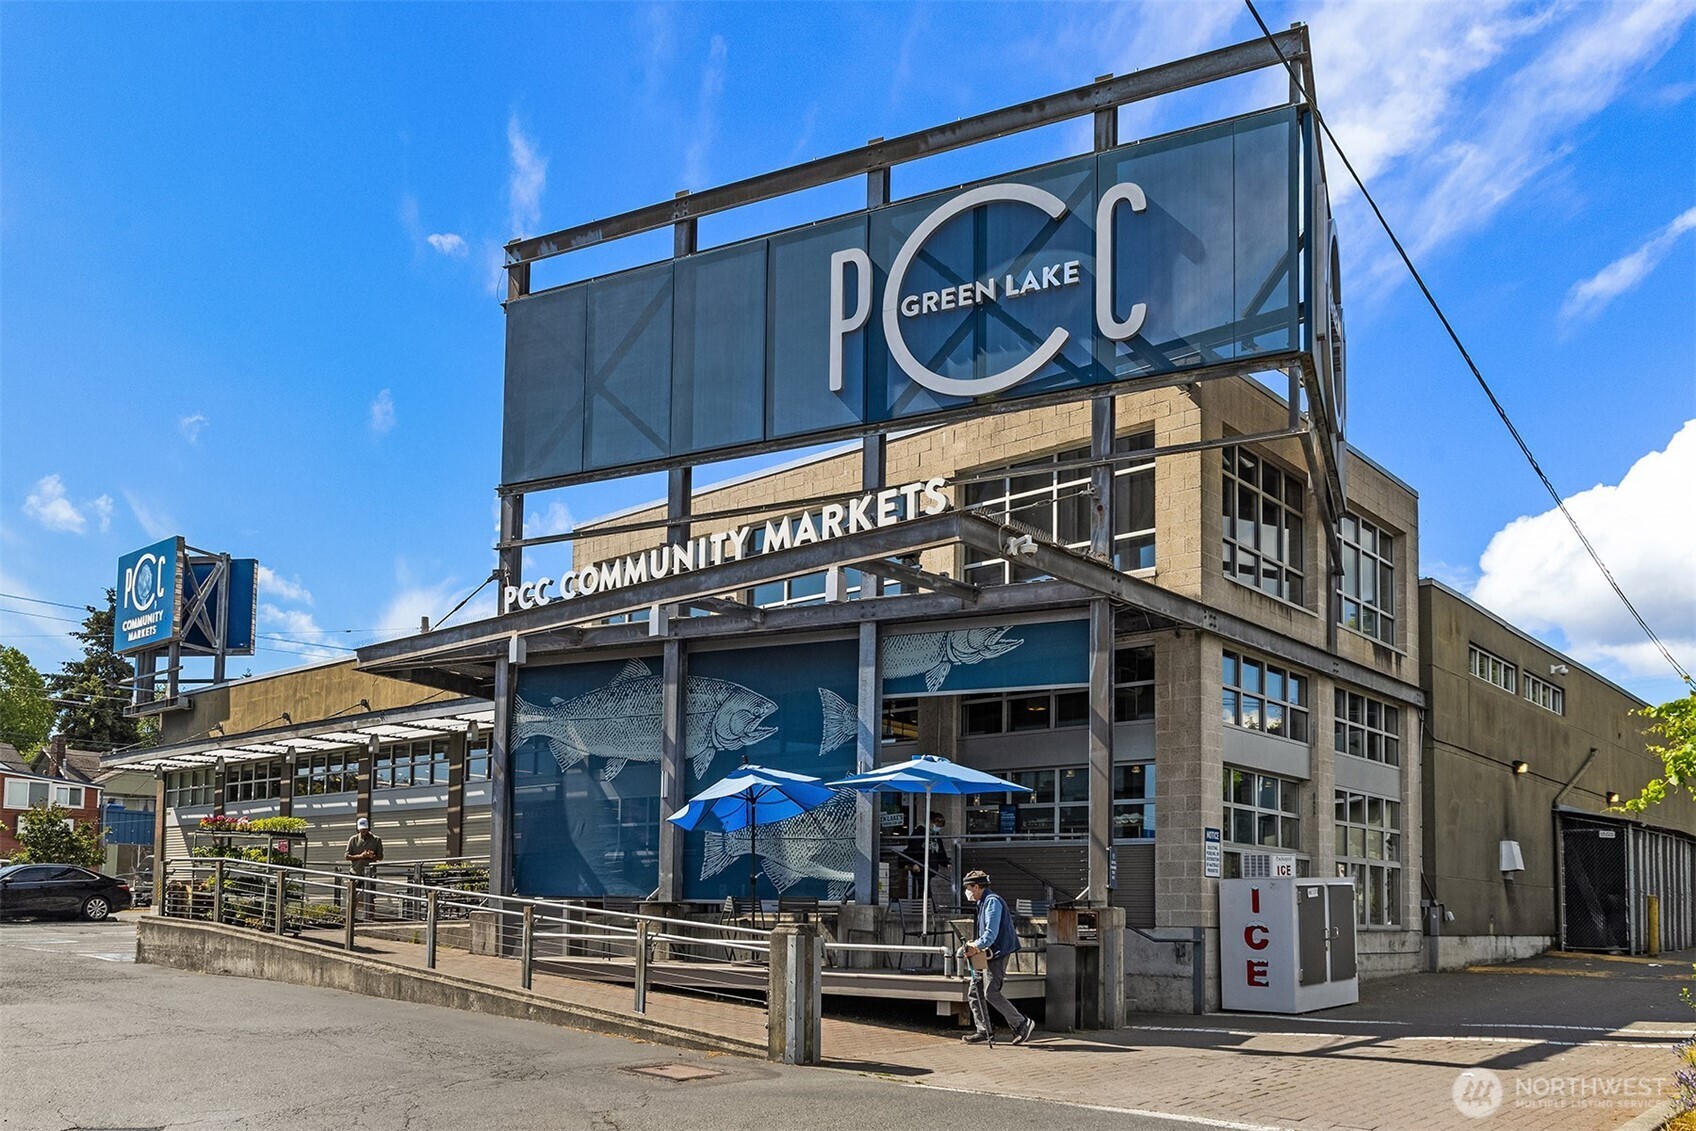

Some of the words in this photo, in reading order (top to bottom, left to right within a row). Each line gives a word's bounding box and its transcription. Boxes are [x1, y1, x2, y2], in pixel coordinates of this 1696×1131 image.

[829, 182, 1147, 397] PCC
[901, 278, 997, 317] GREEN
[1005, 260, 1081, 298] LAKE
[503, 576, 554, 614] PCC
[559, 526, 751, 601] COMMUNITY
[762, 478, 949, 552] MARKETS
[124, 553, 166, 611] PCC
[122, 610, 164, 632] COMMUNITY
[128, 625, 157, 641] MARKETS
[1206, 830, 1219, 840] NOTICE
[1277, 865, 1291, 876] ICE
[1244, 885, 1270, 987] ICE
